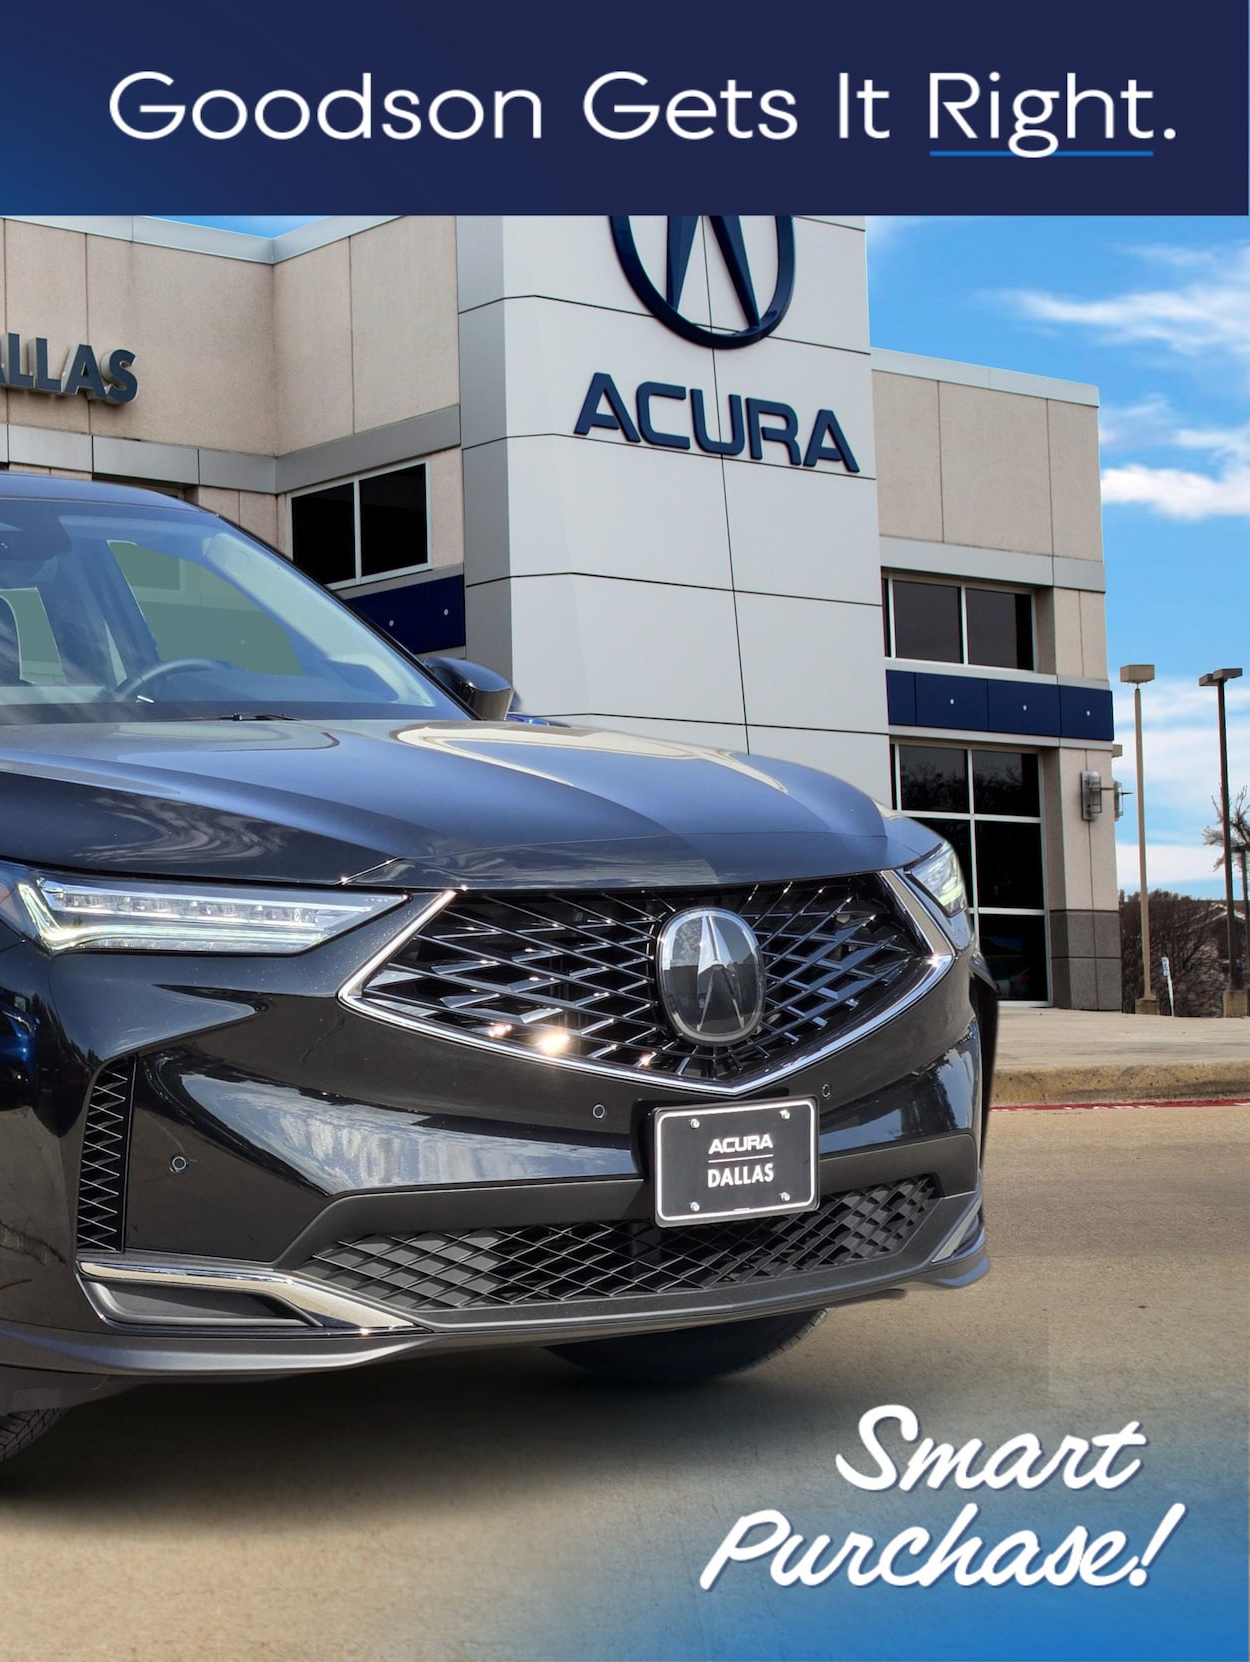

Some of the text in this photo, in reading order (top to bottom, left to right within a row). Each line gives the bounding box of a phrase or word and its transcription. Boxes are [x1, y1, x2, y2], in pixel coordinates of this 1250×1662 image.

[573, 371, 860, 473] ACURA
[708, 1134, 774, 1155] ACURA
[707, 1163, 774, 1188] DALLAS
